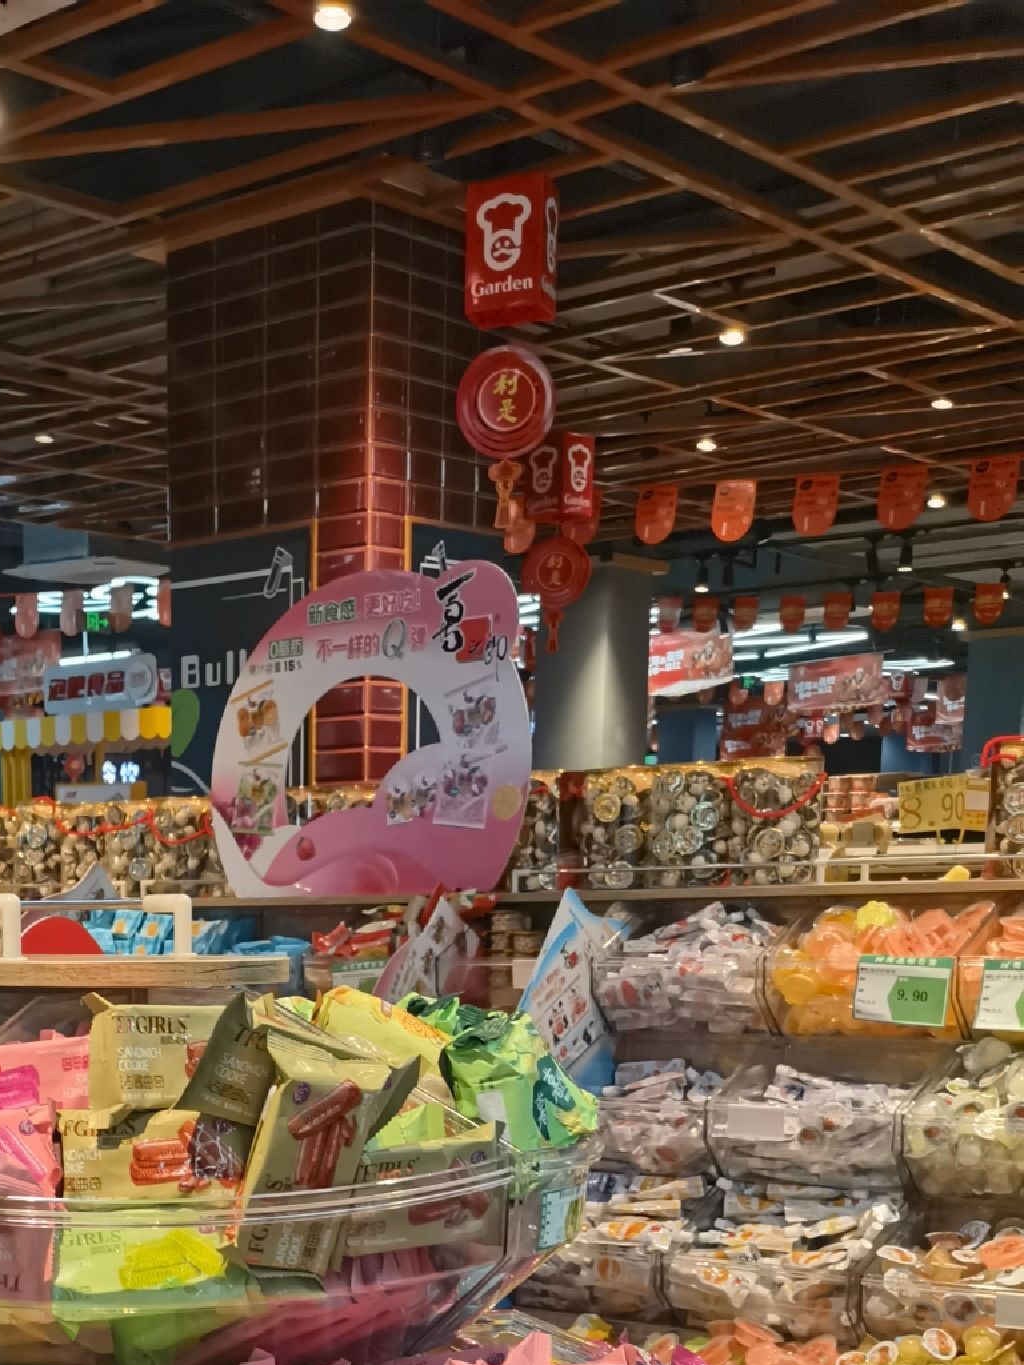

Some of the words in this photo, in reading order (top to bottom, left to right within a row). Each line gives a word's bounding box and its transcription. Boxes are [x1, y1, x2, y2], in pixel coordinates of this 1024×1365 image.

[470, 275, 534, 298] Garden
[492, 374, 518, 424] 利是
[895, 988, 929, 1004] 9.90
